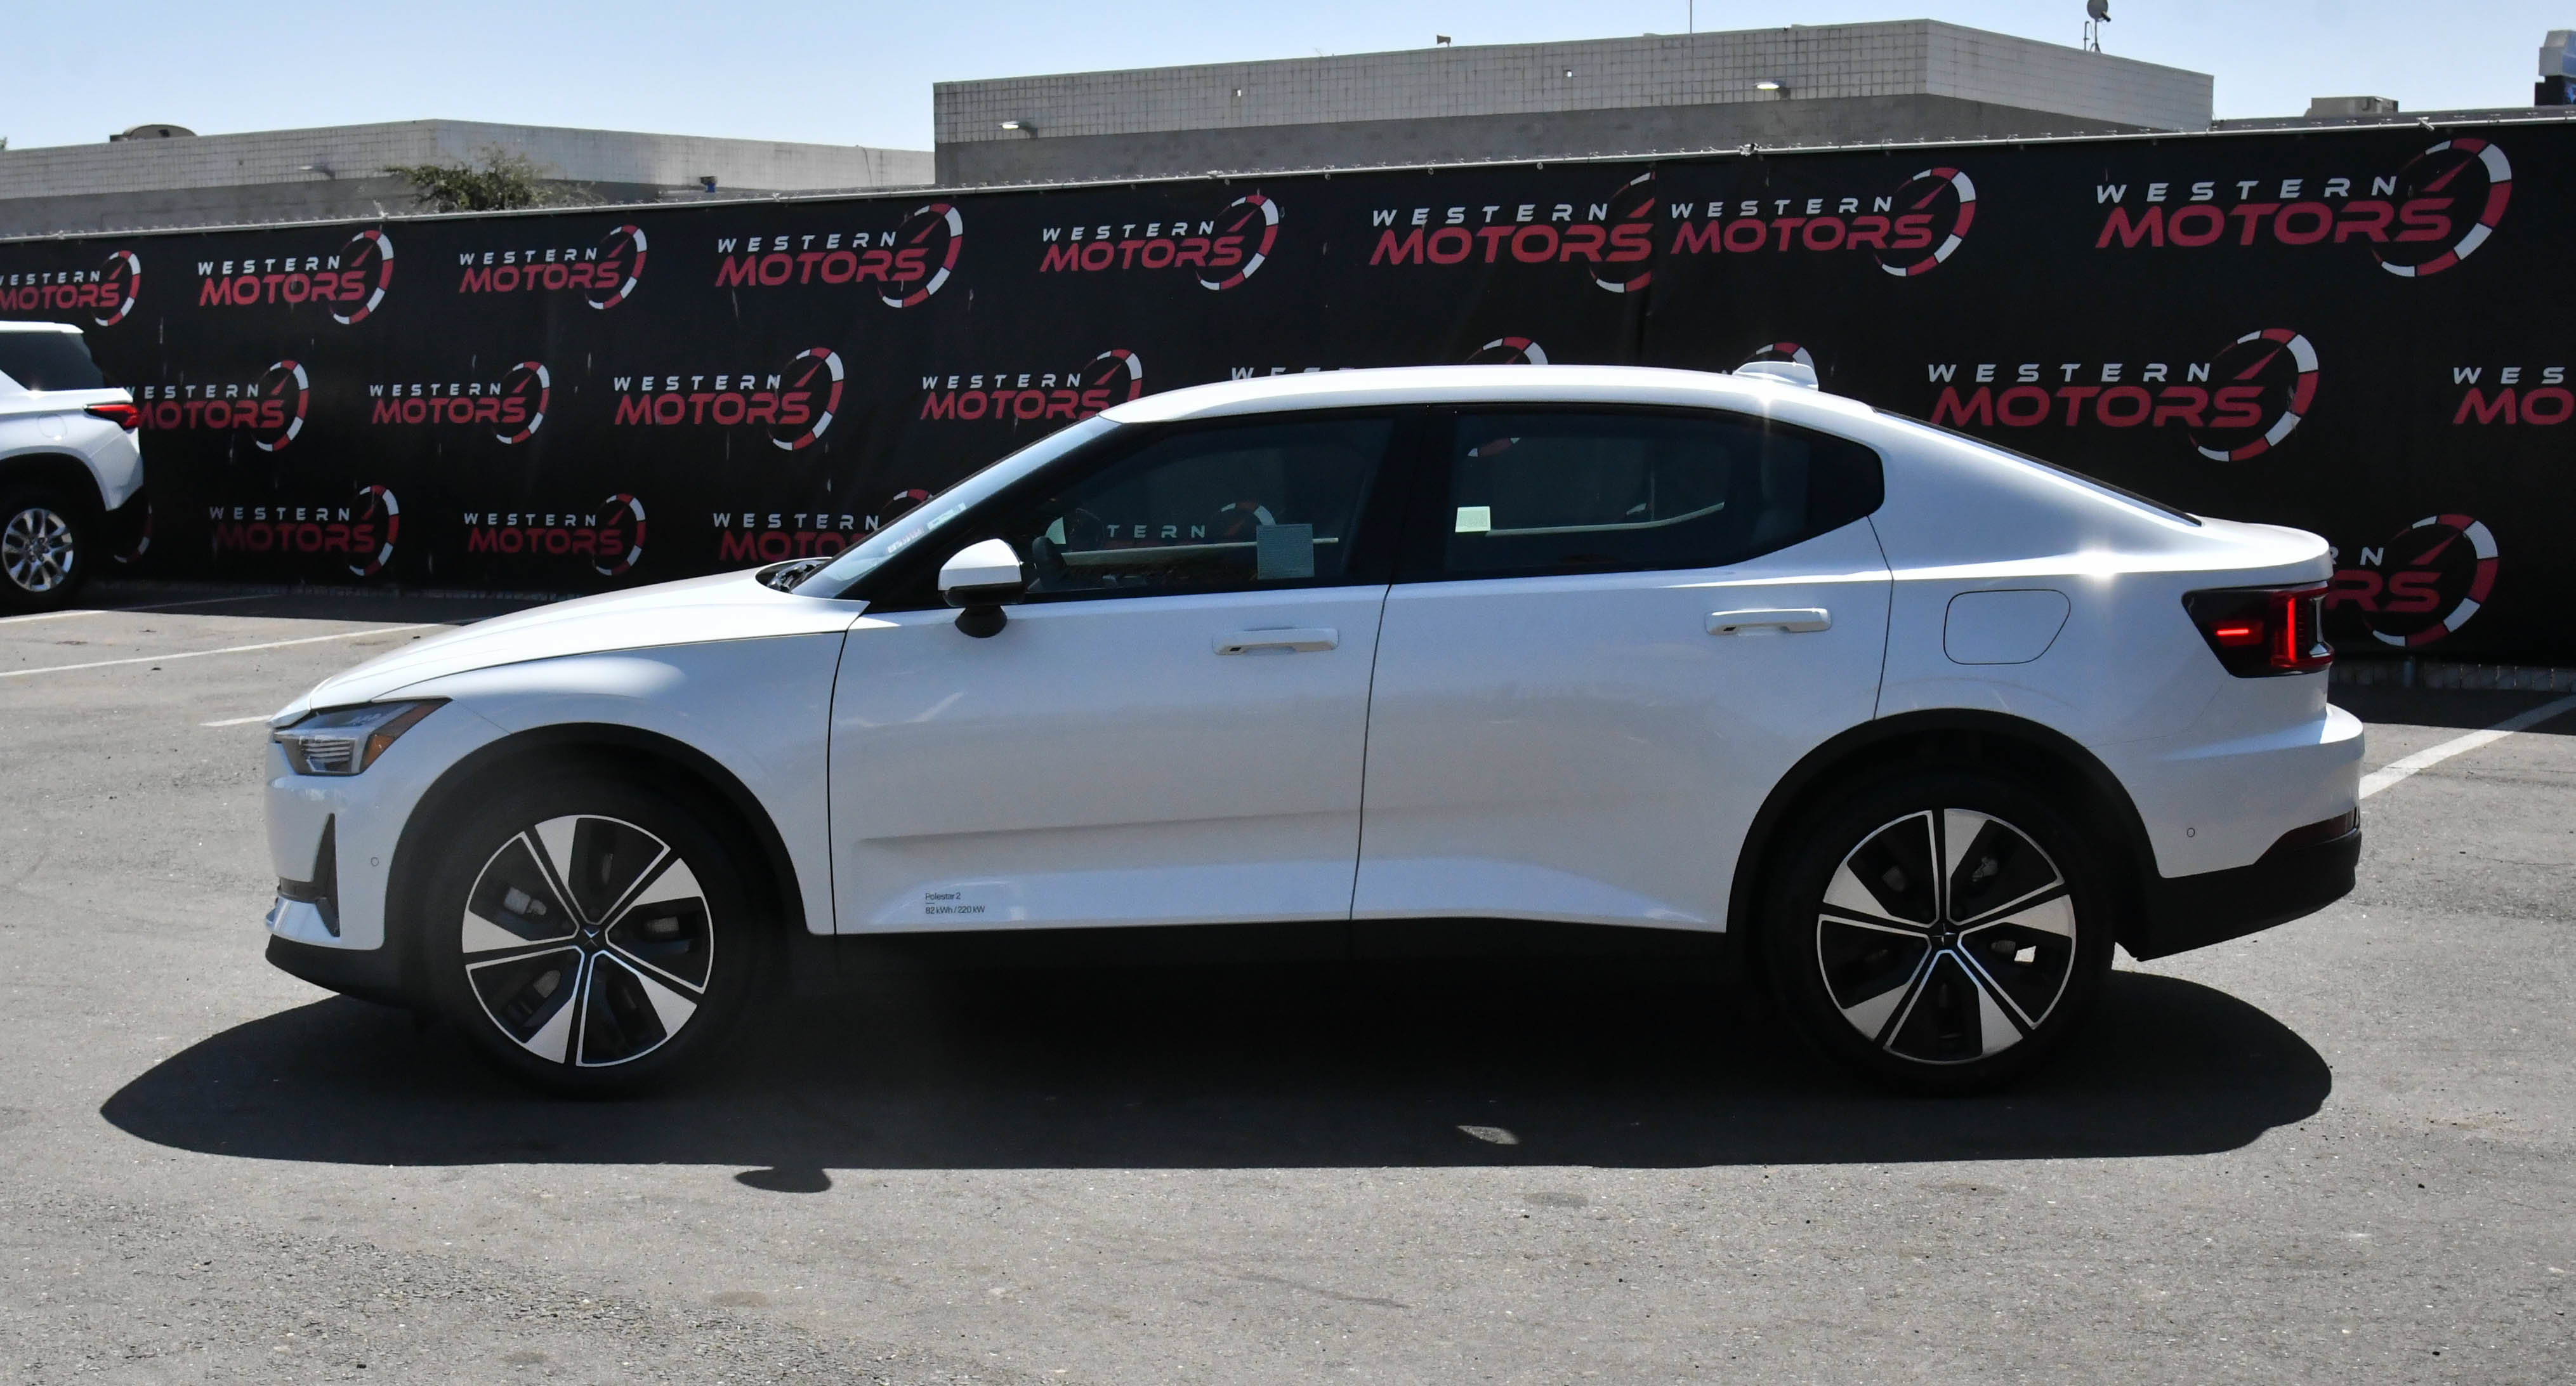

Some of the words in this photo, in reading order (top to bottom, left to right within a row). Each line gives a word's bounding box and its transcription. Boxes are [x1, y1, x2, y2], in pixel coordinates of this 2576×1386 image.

[2097, 176, 2396, 203] WESTERN
[1374, 204, 1607, 227] WESTERN
[1672, 197, 1891, 218] WESTERN
[1043, 221, 1214, 241] WESTERN
[1672, 214, 1933, 254] MOTORS
[2096, 198, 2453, 248] MOTORS
[718, 232, 896, 253] WESTERN
[1041, 236, 1244, 272] MOTORS
[1371, 223, 1652, 265] MOTORS
[199, 256, 339, 275] WESTERN
[460, 248, 596, 265] WESTERN
[716, 248, 927, 286] MOTORS
[200, 271, 364, 306] MOTORS
[460, 261, 620, 293] MOTORS
[614, 375, 780, 391] WESTERN
[923, 374, 1080, 389] WESTERN
[1928, 363, 2210, 382] WESTERN
[370, 383, 501, 396] WESTERN
[373, 397, 525, 423] MOTORS
[615, 392, 810, 425] MOTORS
[922, 389, 1110, 419] MOTORS
[1931, 386, 2263, 427] MOTORS
[210, 507, 350, 521] WESTERN
[464, 513, 596, 526] WESTERN
[714, 513, 879, 531] WESTERN
[218, 523, 375, 553] MOTORS
[469, 527, 622, 554] MOTORS
[720, 531, 866, 562] MOTO
